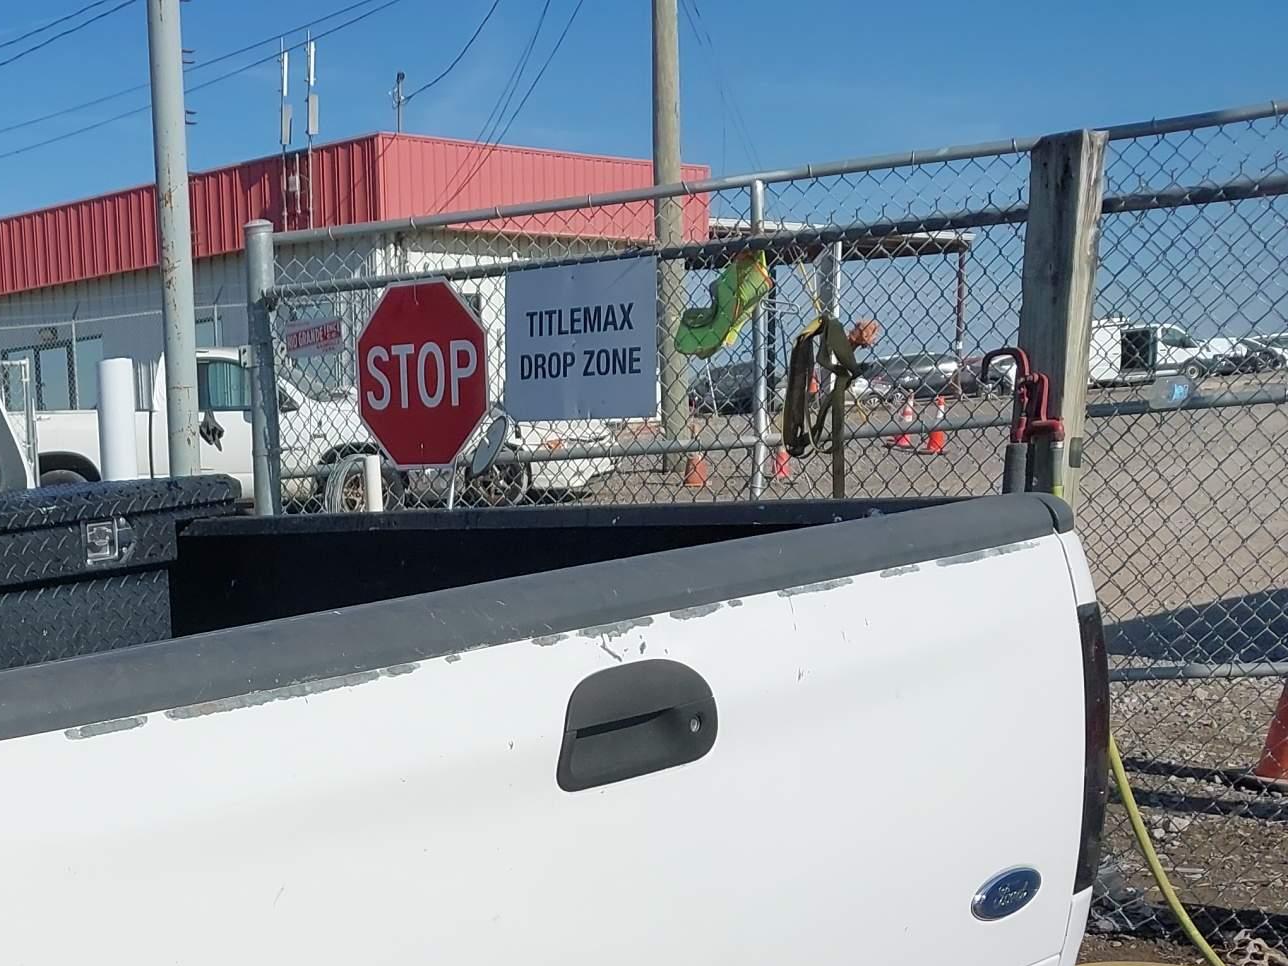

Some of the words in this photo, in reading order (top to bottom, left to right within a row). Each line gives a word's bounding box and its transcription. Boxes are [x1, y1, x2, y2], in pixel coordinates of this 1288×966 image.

[526, 302, 634, 337] TITLEMAX
[366, 339, 478, 411] STOP
[520, 351, 576, 381] DROP
[582, 346, 641, 377] ZONE
